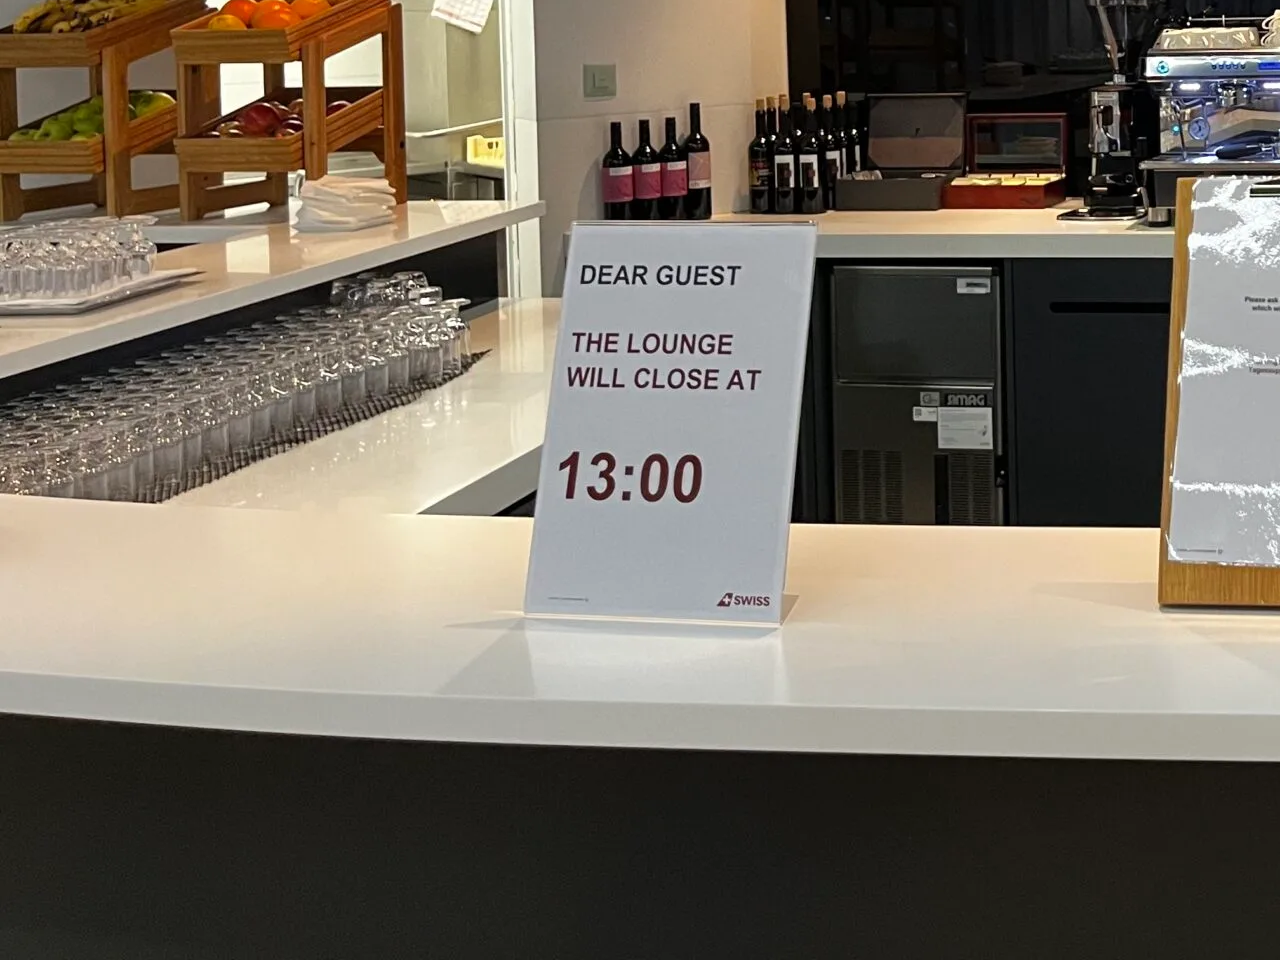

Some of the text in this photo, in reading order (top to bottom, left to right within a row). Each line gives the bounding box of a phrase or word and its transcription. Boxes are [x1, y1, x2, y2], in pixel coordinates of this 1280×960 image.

[580, 265, 742, 286] DEAR GUEST
[572, 332, 734, 355] THE LOUNGE
[567, 366, 762, 390] WILL CLOSE AT
[558, 451, 703, 504] 13:00
[733, 595, 770, 607] SWISS
